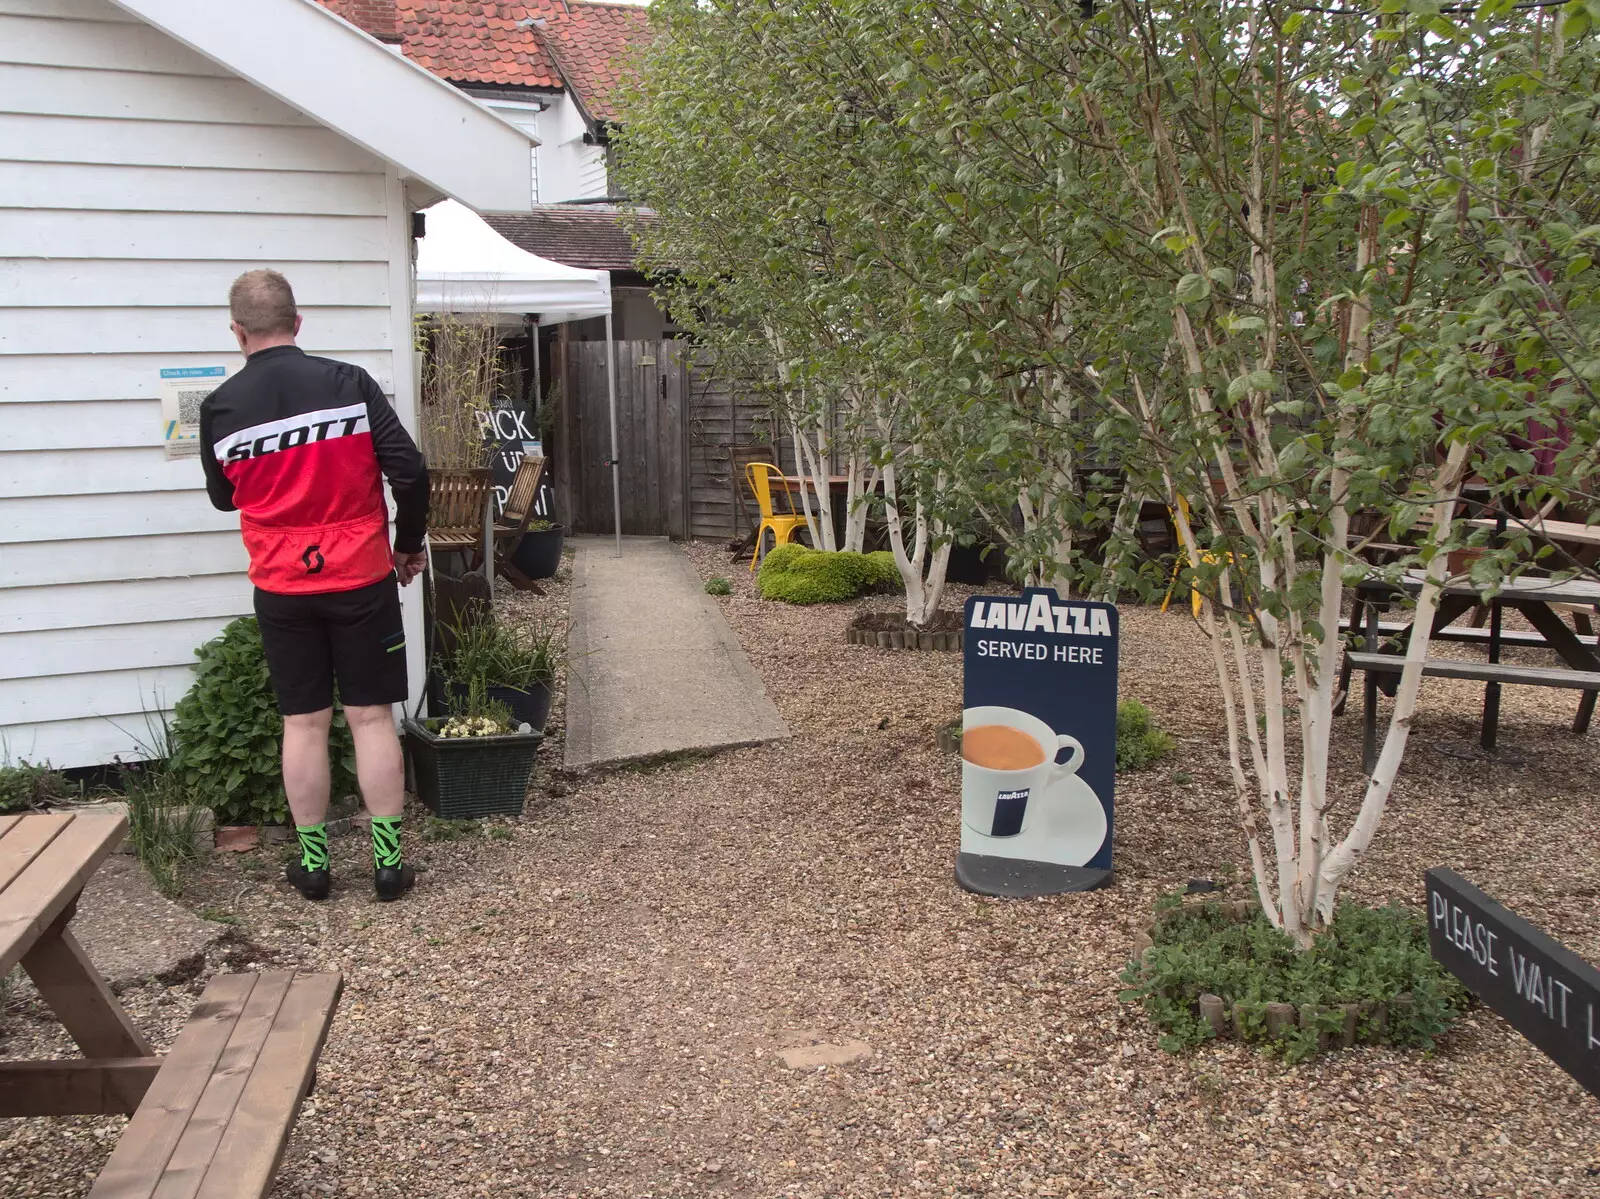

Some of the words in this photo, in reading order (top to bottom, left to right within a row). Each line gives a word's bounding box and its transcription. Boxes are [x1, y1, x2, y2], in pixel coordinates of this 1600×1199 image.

[227, 414, 366, 462] SCOTT
[475, 409, 535, 440] PICK
[970, 594, 1112, 637] LAVAZZA
[977, 639, 1048, 661] SERVED
[1053, 645, 1103, 665] HERE
[998, 791, 1029, 800] LAVAZZA
[1432, 890, 1498, 977] PLEASE
[1508, 946, 1573, 1029] WAIT
